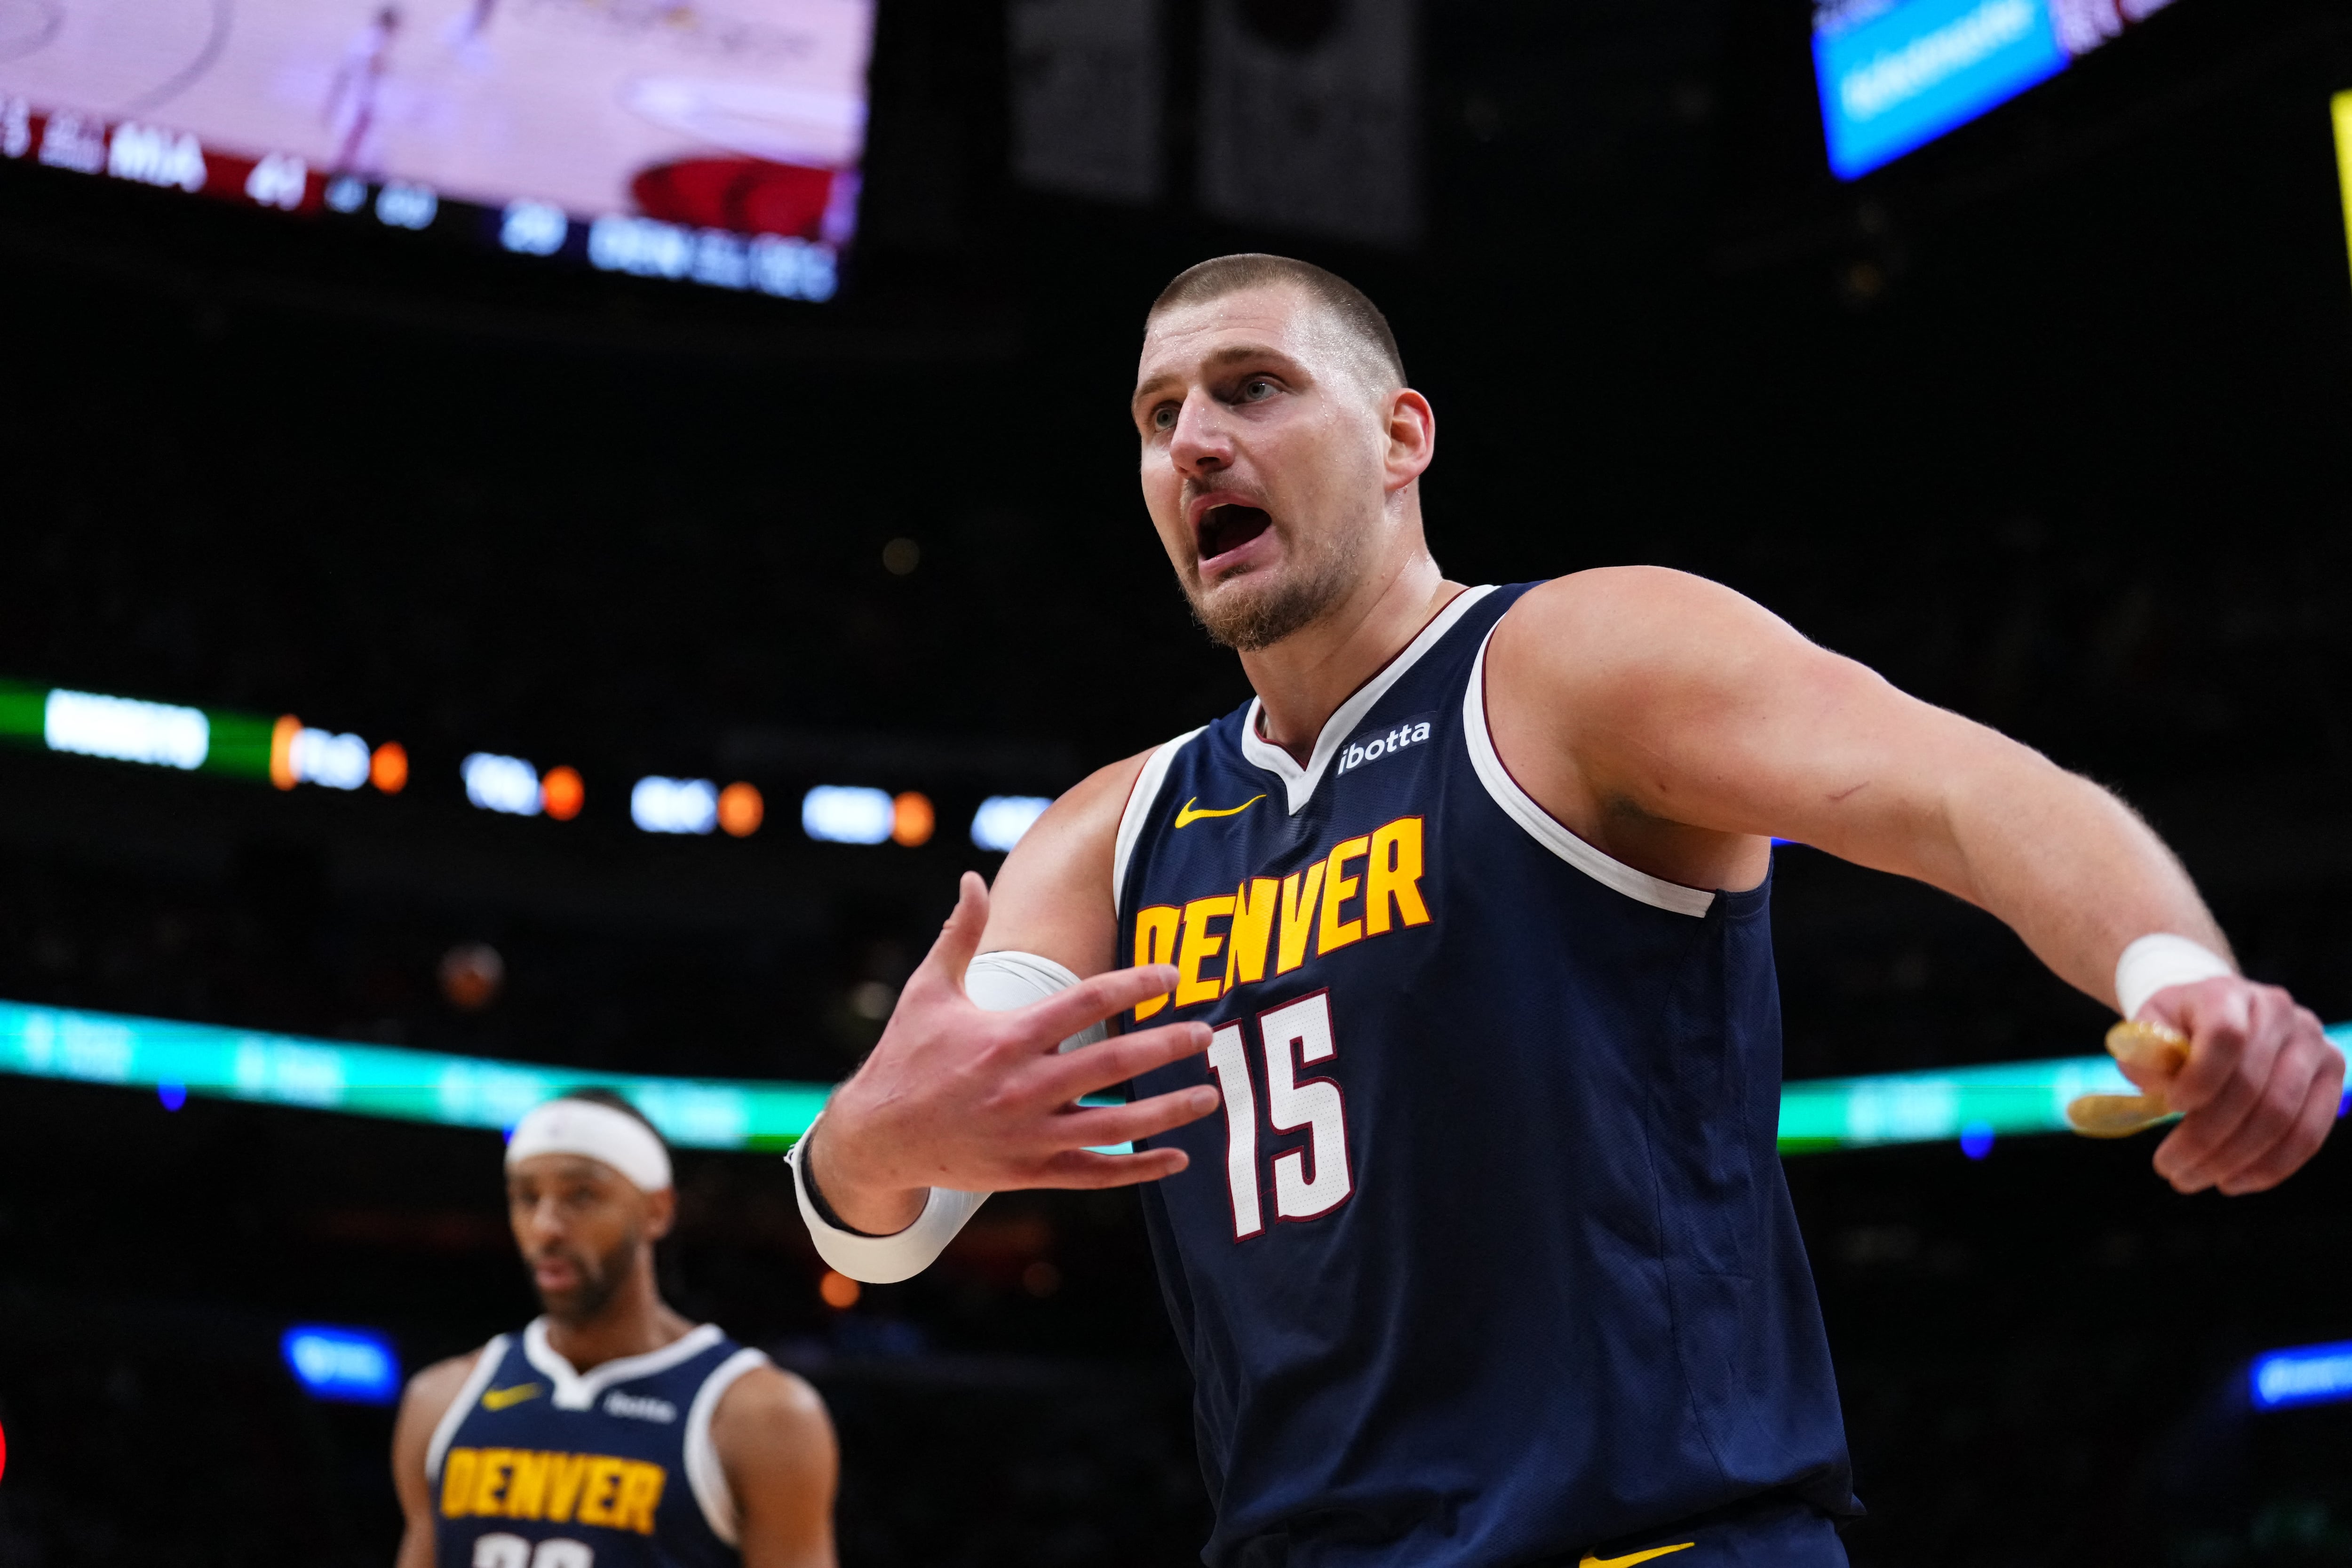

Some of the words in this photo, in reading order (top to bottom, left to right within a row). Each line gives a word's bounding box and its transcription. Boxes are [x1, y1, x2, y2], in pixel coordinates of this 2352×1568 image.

[1338, 722, 1430, 775] ibotta
[1133, 814, 1433, 1024] DENVER
[1207, 987, 1354, 1243] 15
[440, 1446, 668, 1536] DENVER
